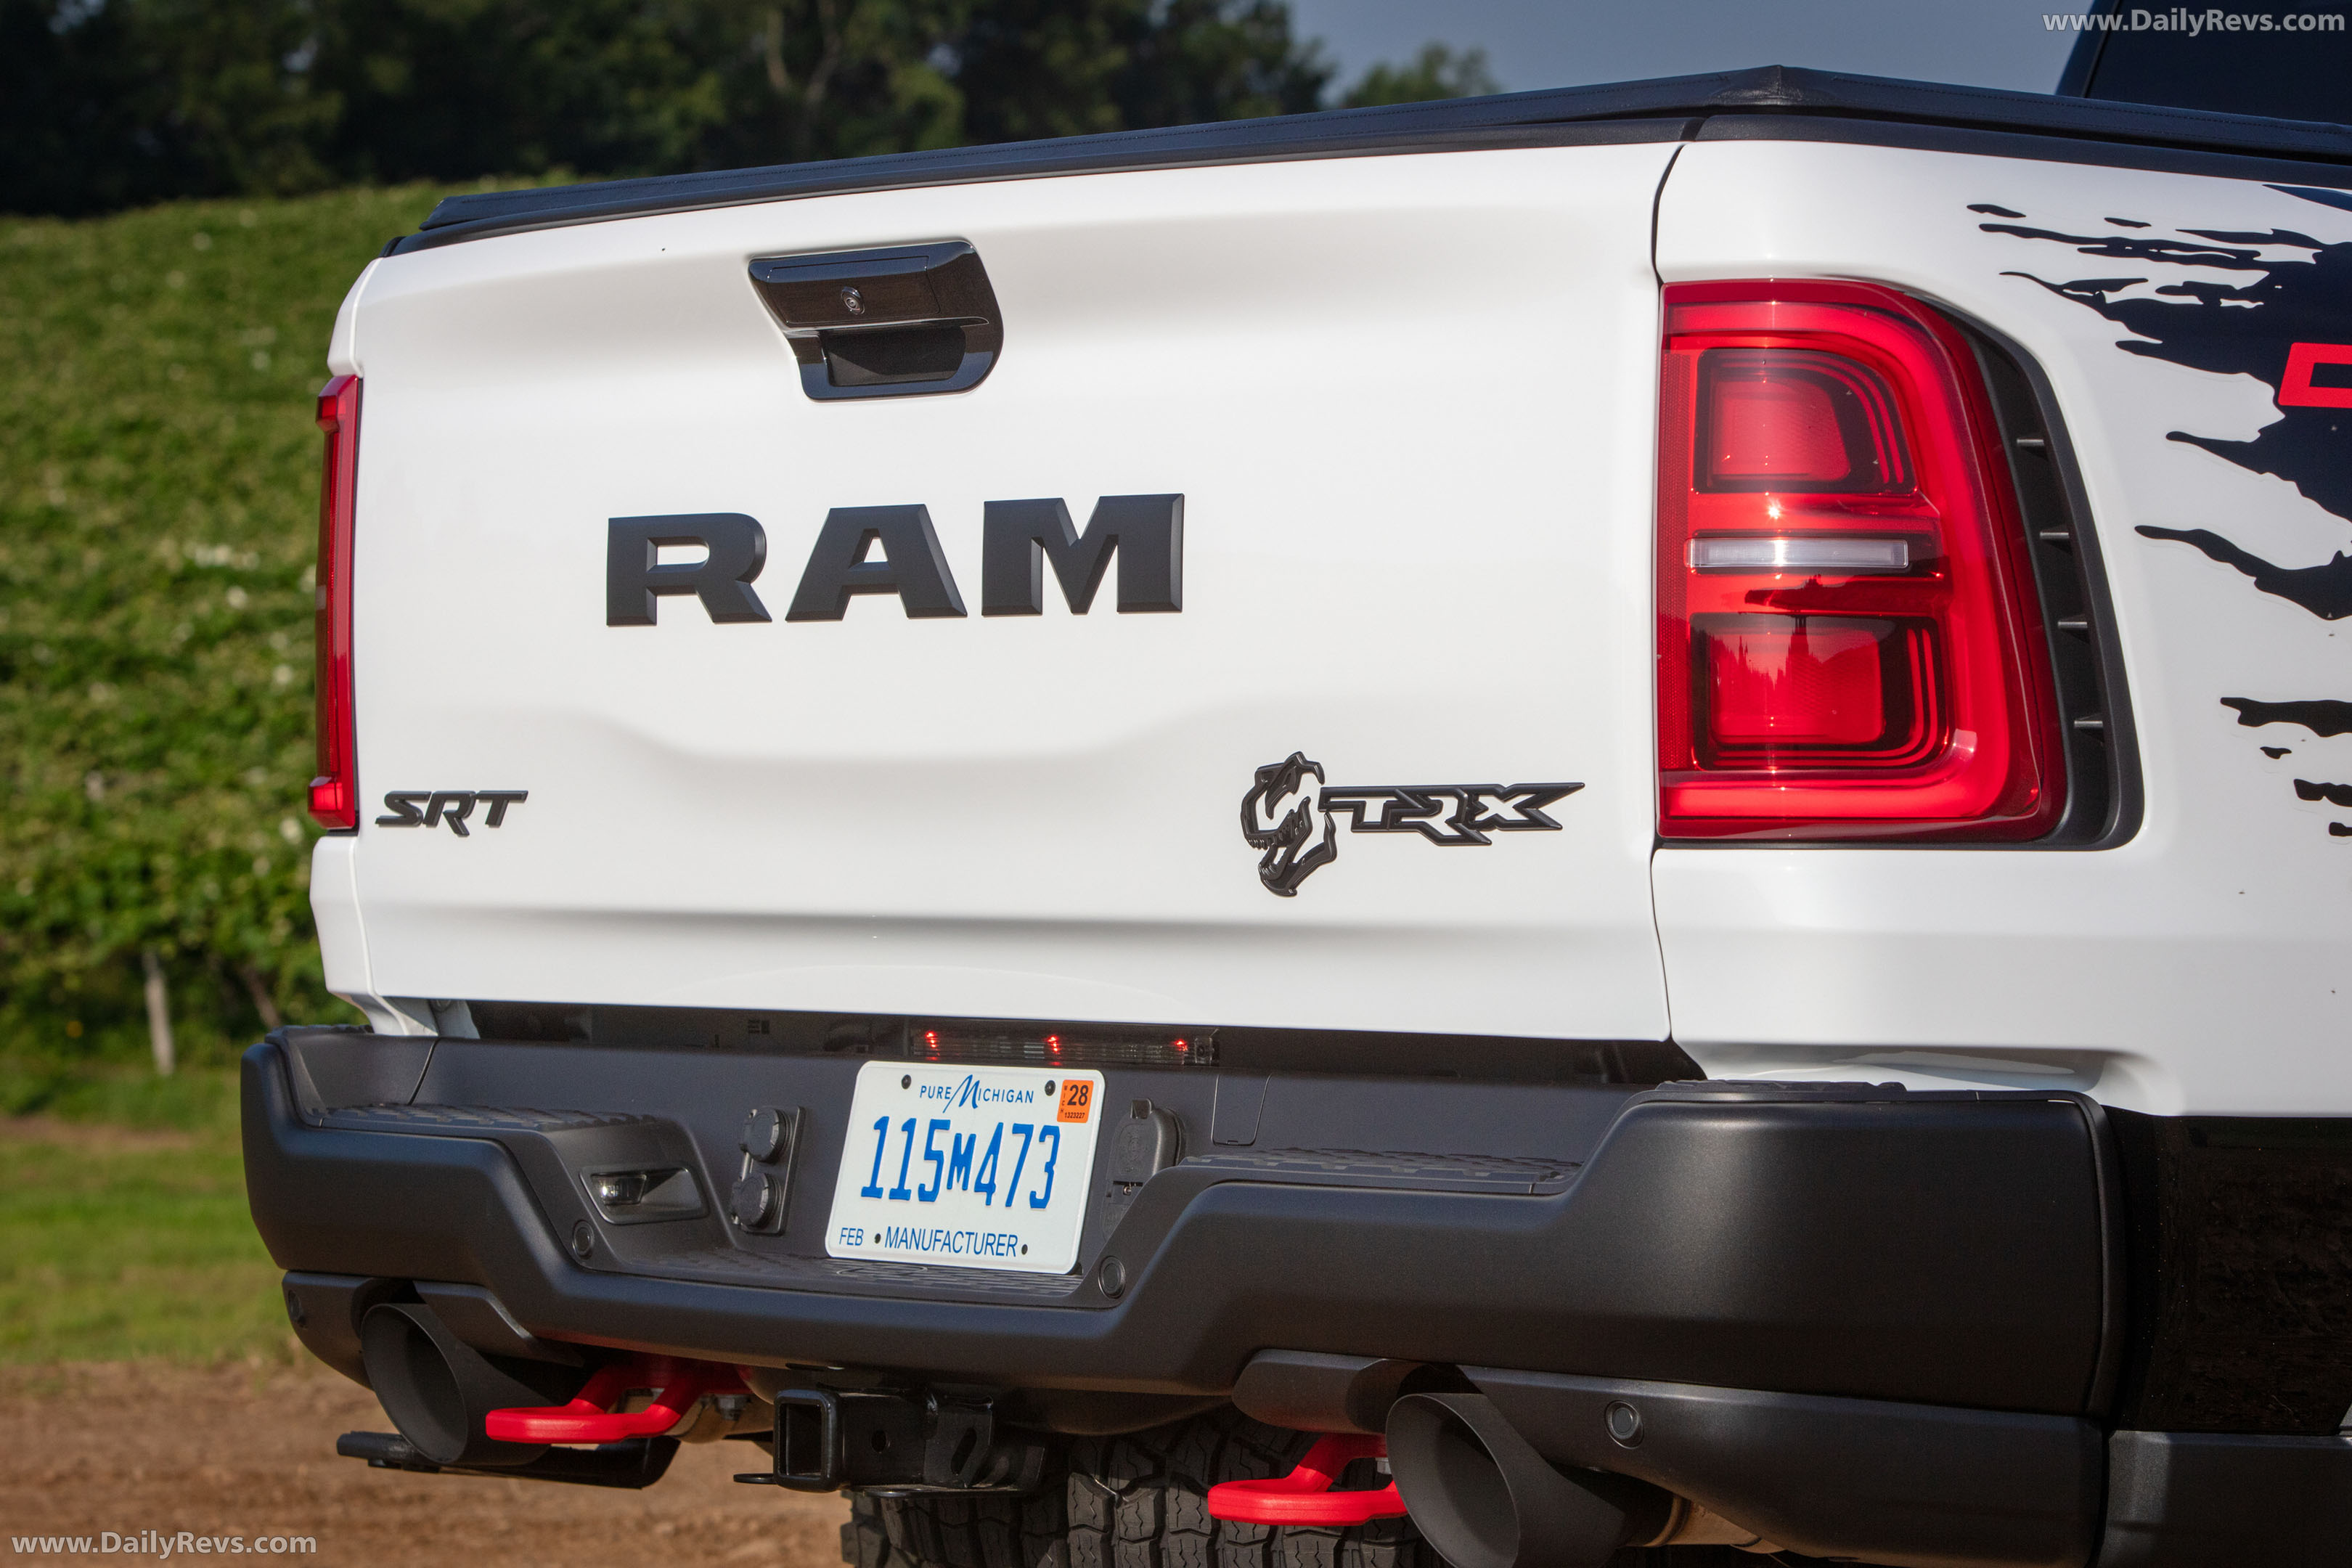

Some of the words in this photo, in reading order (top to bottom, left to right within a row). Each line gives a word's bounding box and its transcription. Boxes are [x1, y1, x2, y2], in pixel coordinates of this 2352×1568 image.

[606, 493, 1185, 627] RAM
[375, 790, 529, 837] SRT
[1318, 782, 1585, 846] TRX
[919, 1085, 952, 1100] PURE
[942, 1074, 1034, 1114] MICHIGAN
[1067, 1084, 1089, 1106] 28
[861, 1116, 1061, 1209] 115M473
[839, 1227, 865, 1246] FEB
[884, 1225, 1018, 1257] MANUFACTURER
